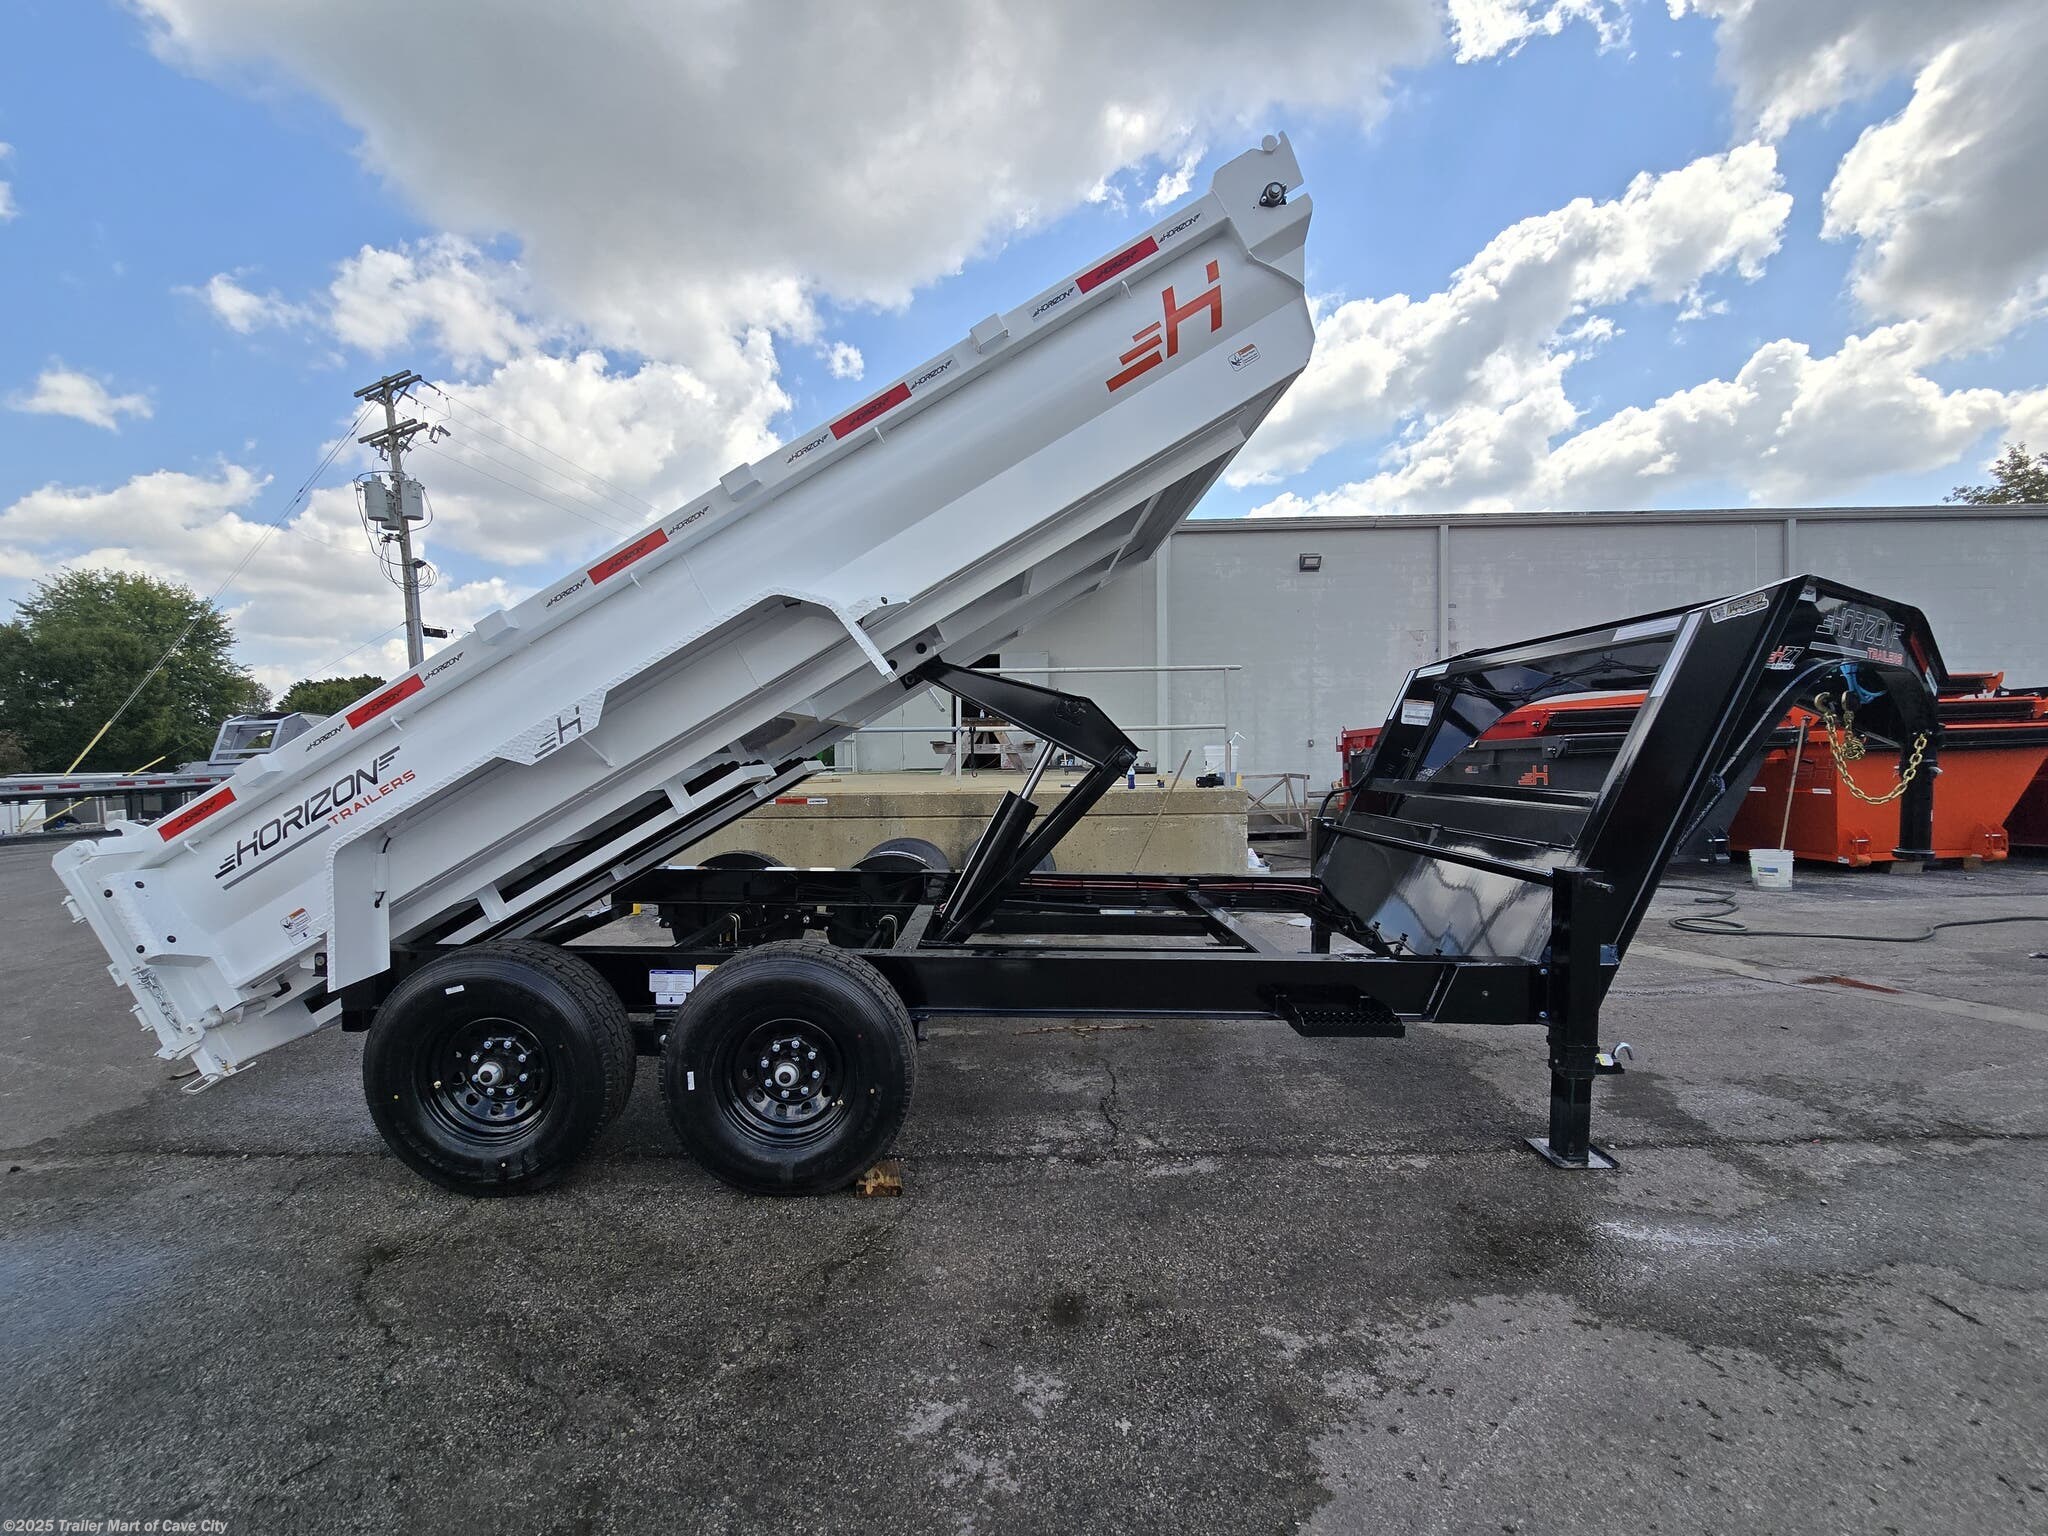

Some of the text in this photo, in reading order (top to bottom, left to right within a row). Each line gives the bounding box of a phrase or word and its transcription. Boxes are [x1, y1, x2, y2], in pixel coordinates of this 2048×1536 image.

[1158, 213, 1201, 243] HORIZON
[1032, 286, 1075, 318] HORIZON
[910, 360, 953, 390] HORIZON
[786, 433, 829, 464] HORIZON
[667, 505, 710, 535] HORIZON
[546, 577, 587, 607] HORIZON
[1816, 608, 1904, 648] HORIZON
[423, 651, 464, 681] HORIZON
[305, 722, 346, 752] HORIZON
[214, 745, 401, 880] HORIZON
[328, 769, 416, 826] TRAILERS
